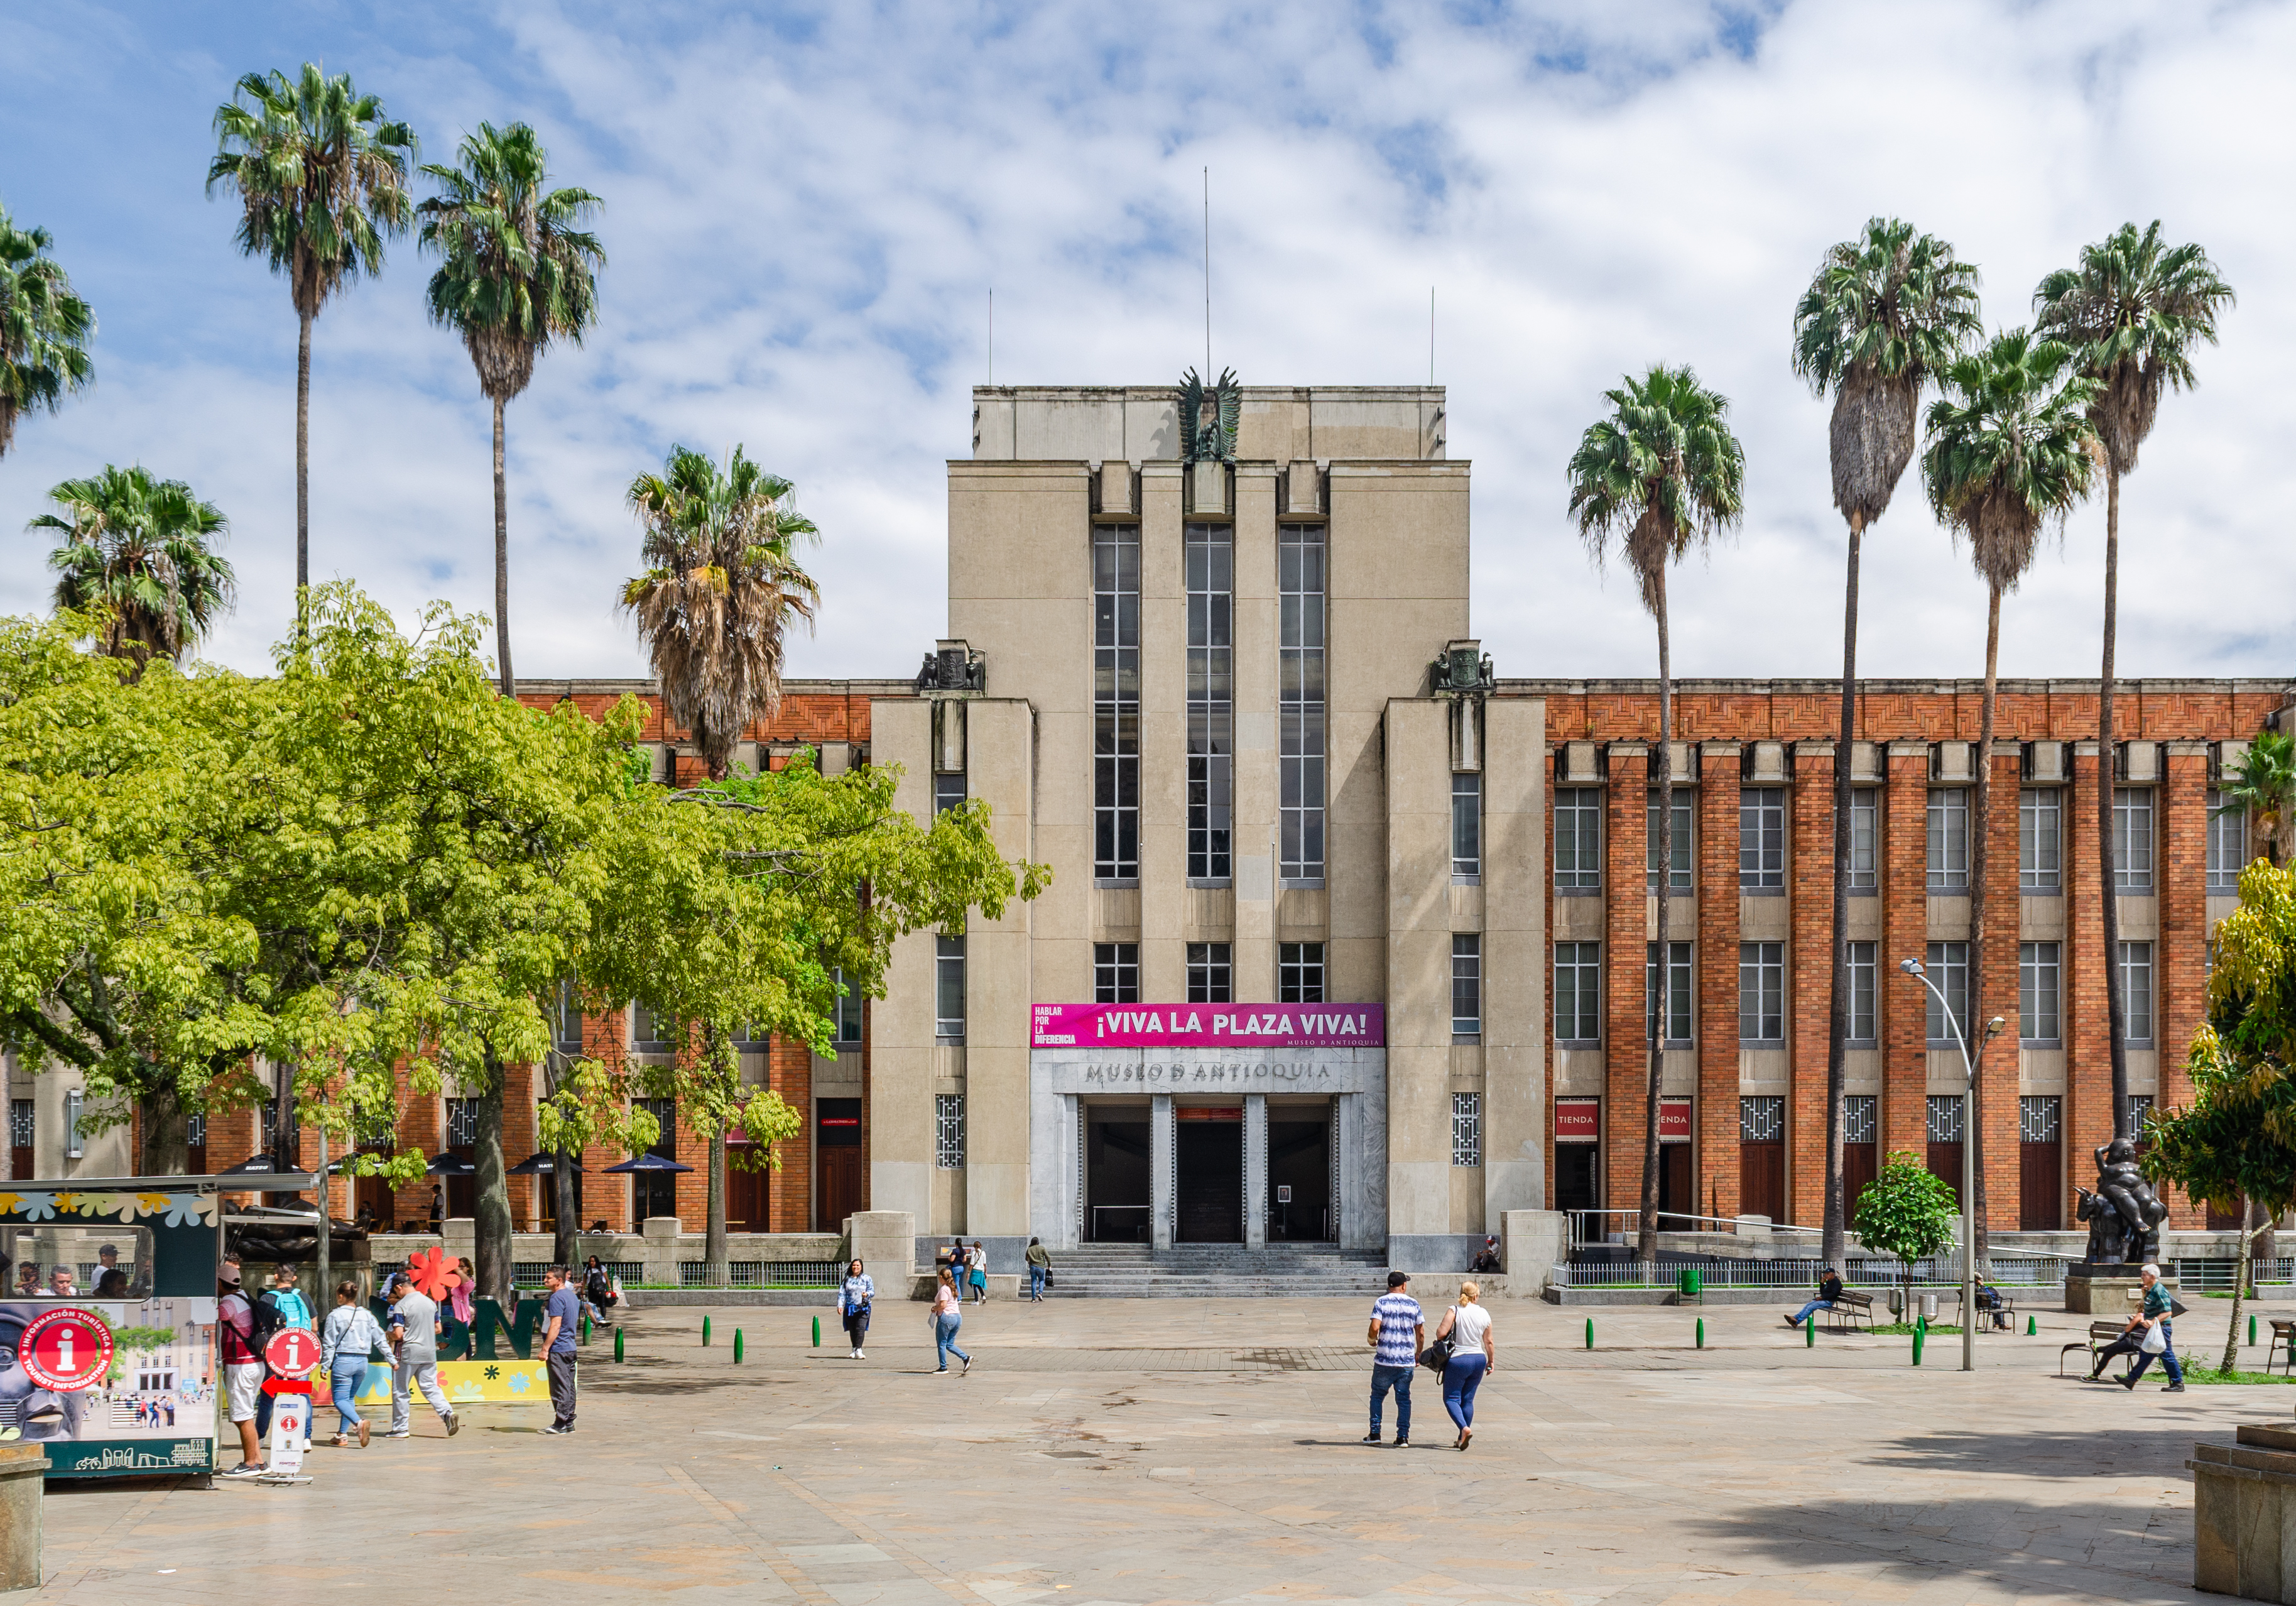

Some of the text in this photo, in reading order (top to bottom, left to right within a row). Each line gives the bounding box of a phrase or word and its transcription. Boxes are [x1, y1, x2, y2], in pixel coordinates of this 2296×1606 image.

[1035, 1007, 1062, 1016] HABLAR
[1035, 1016, 1050, 1025] POR
[1097, 1012, 1367, 1038] ¡VIVA LA PLAZA VIVA!
[1035, 1025, 1044, 1034] LA
[1035, 1034, 1076, 1044] DIFERENCIA
[1087, 1063, 1163, 1078] MUSEO
[1195, 1063, 1330, 1080] ANTIOQUIA
[1558, 1116, 1594, 1124] TIENDA
[1660, 1115, 1687, 1124] ENDA
[22, 1309, 111, 1348] INFORMACIÓN TURÍSTICA
[268, 1360, 286, 1375] TOURIST
[23, 1358, 109, 1389] TOURIST INFORMATION
